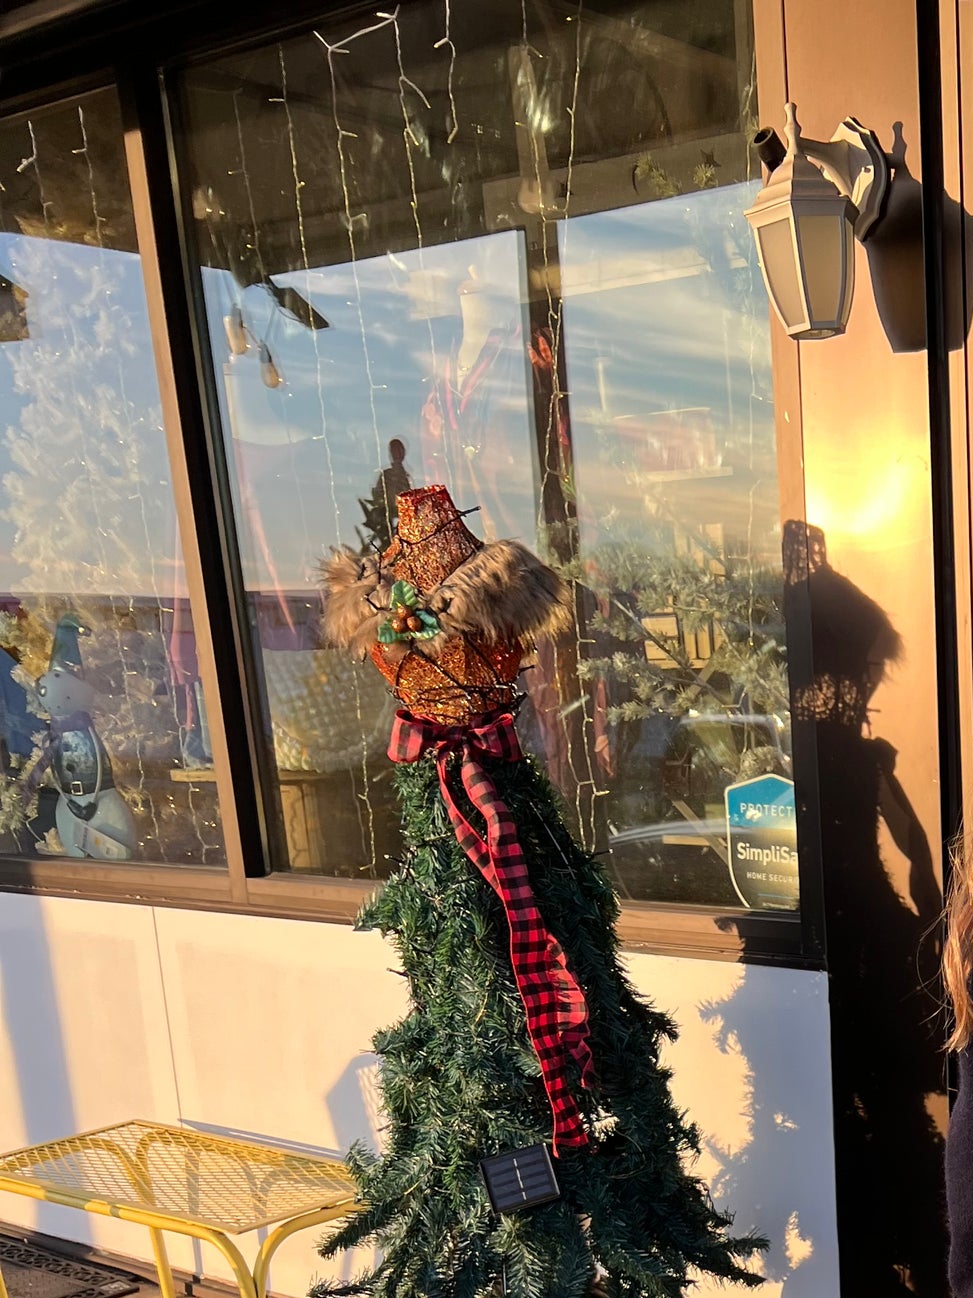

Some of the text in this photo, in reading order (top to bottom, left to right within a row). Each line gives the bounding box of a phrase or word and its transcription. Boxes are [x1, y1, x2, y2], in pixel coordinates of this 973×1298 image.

[740, 802, 793, 817] PROTECT
[737, 842, 798, 865] SimpliSa
[746, 871, 767, 881] HOME
